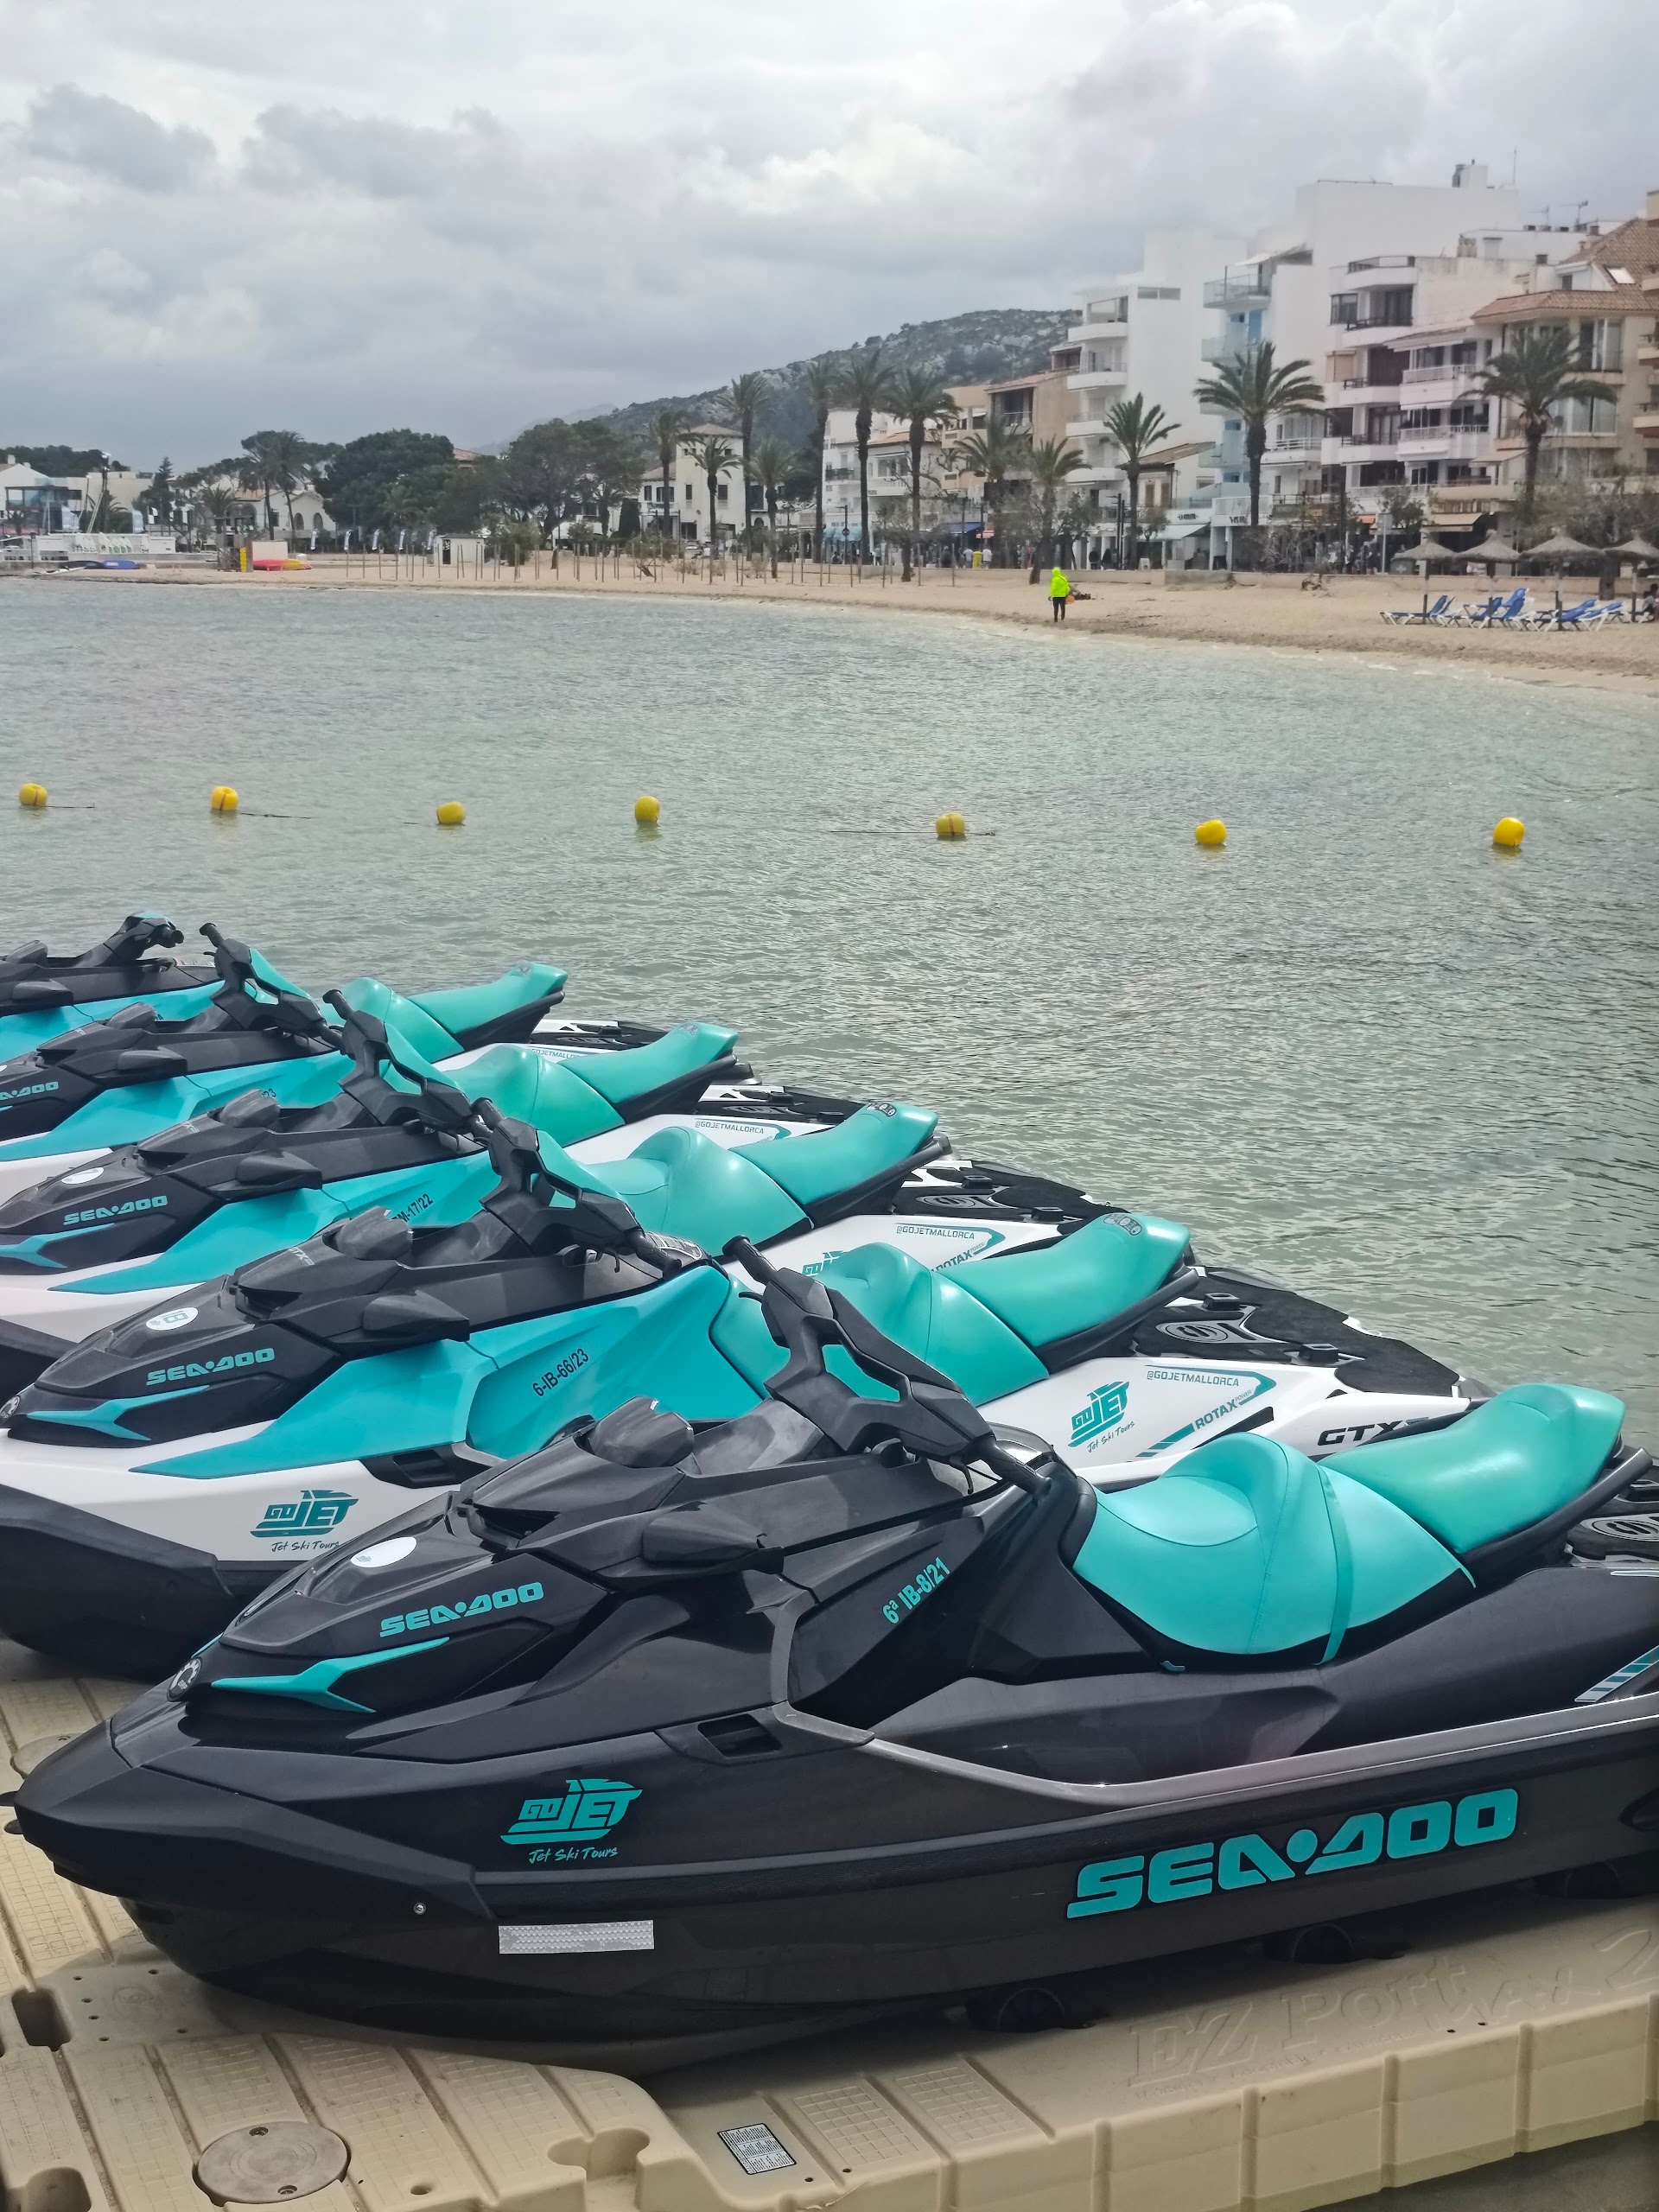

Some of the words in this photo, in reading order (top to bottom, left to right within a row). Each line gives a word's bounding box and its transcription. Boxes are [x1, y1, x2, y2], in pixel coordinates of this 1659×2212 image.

[695, 1121, 765, 1135] @GOJETMALLORCA
[896, 1225, 976, 1240] @GOJETMALLORCA
[532, 1348, 589, 1397] 6-IB-66/23
[1147, 1370, 1240, 1387] @GOJETMALLORCA
[1195, 1398, 1239, 1430] ROTAX
[1235, 1389, 1252, 1402] POWER
[1086, 1439, 1099, 1453] Jet
[1101, 1432, 1115, 1446] Ski
[1116, 1421, 1135, 1437] Tours
[270, 1541, 289, 1553] Jet
[291, 1541, 310, 1551] Ski
[312, 1541, 340, 1549] Tours
[898, 1557, 950, 1610] IB-8/21
[529, 1847, 553, 1865] Jet
[555, 1847, 579, 1861] Ski
[582, 1847, 619, 1860] Tours
